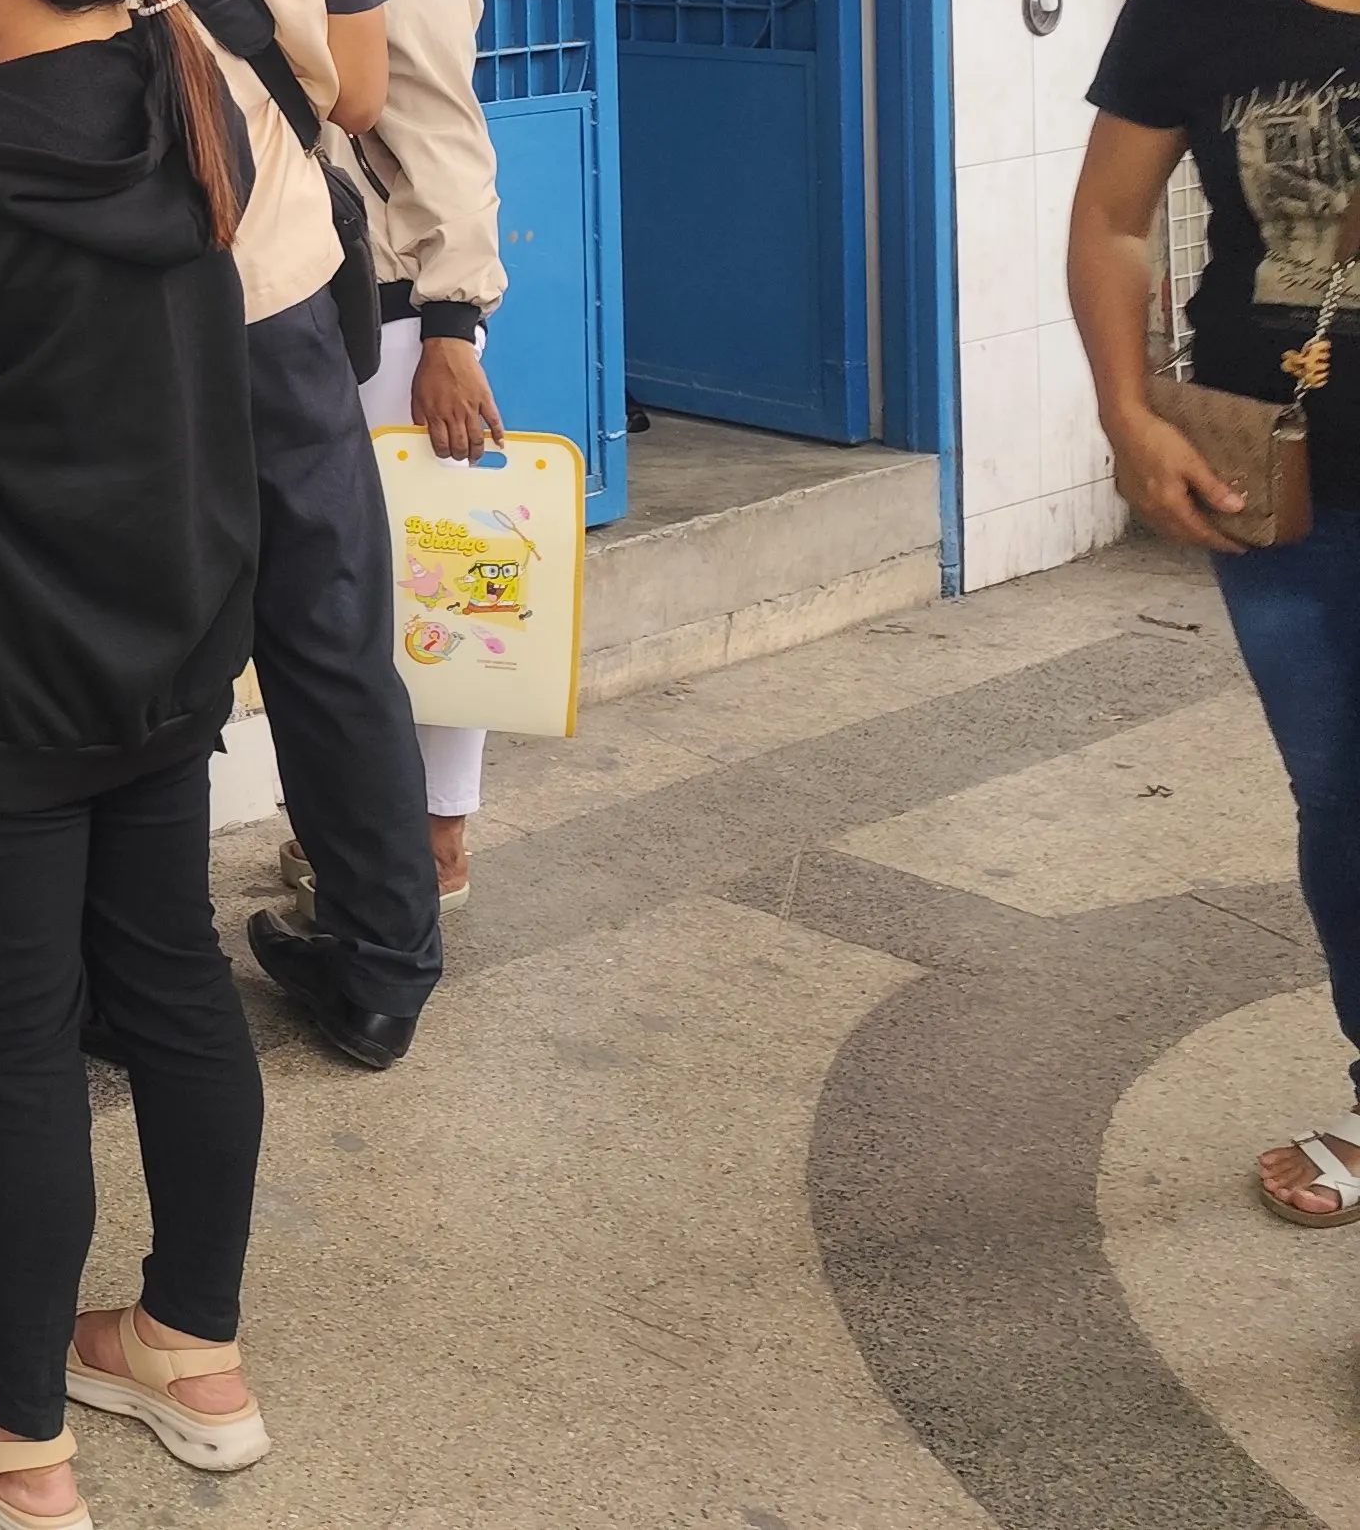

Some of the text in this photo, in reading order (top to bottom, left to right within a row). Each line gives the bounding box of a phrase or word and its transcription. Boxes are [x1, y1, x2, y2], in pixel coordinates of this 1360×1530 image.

[405, 516, 468, 537] Be the
[419, 533, 489, 557] change
